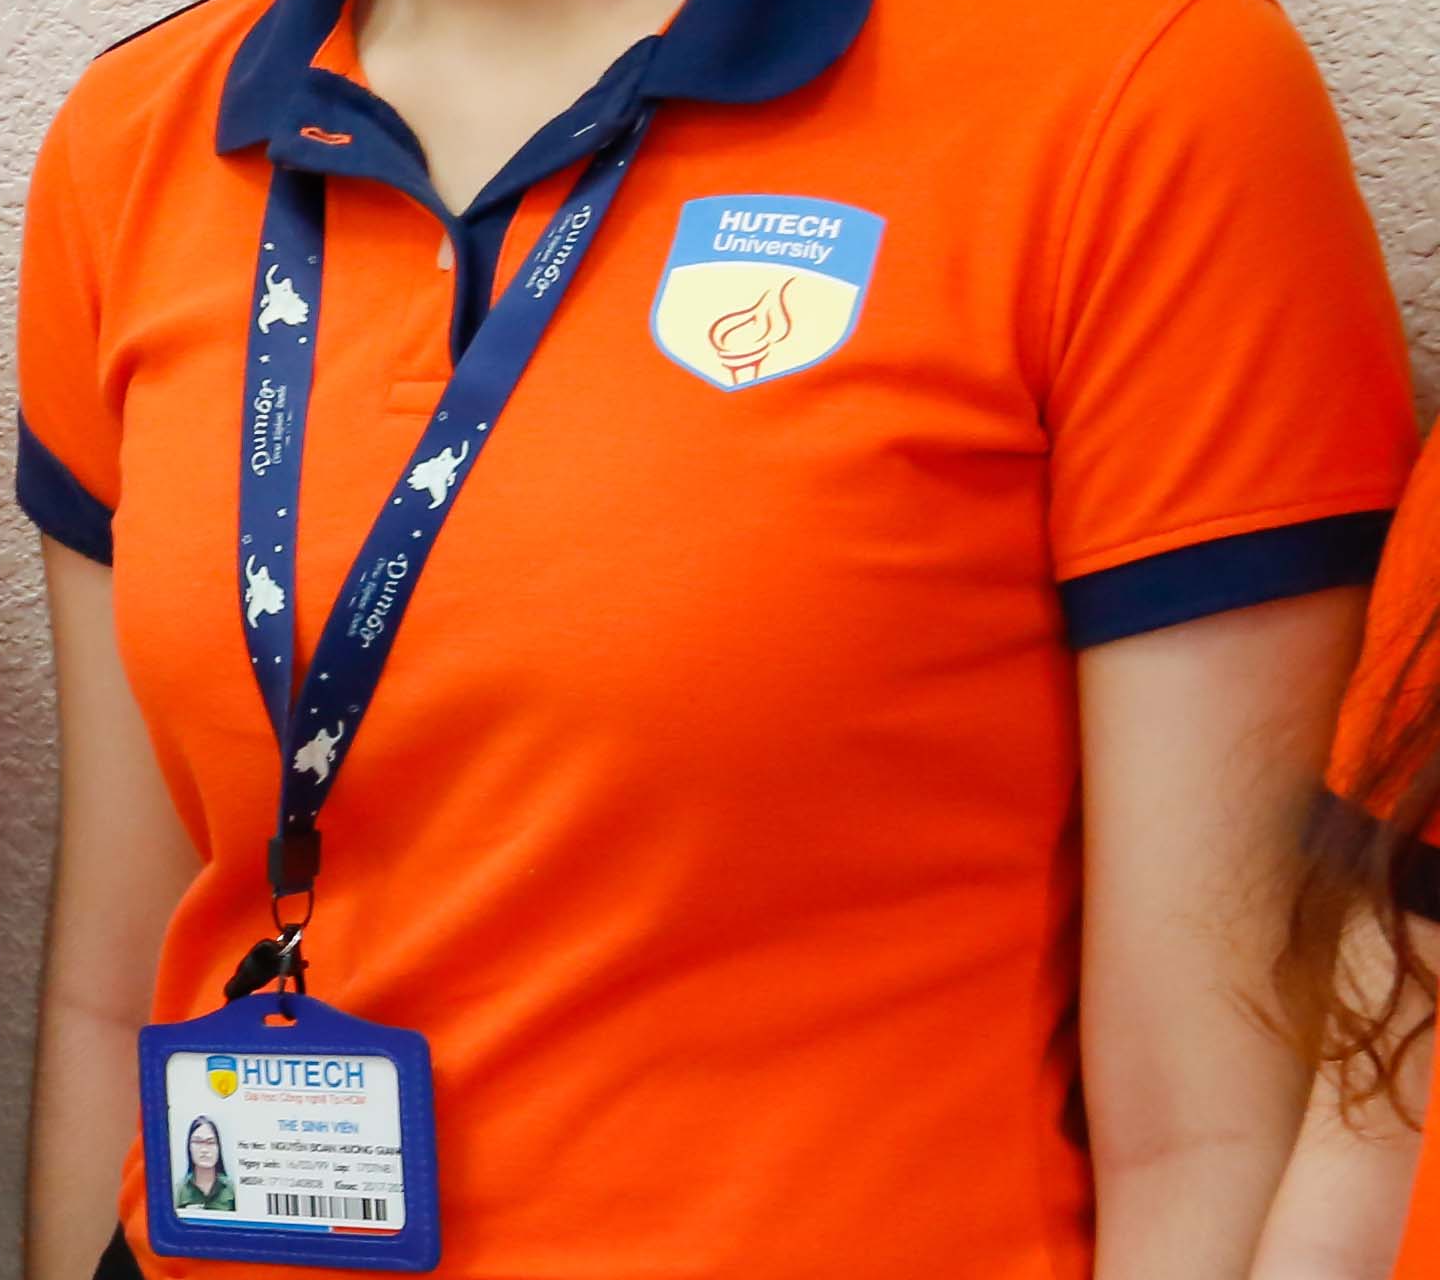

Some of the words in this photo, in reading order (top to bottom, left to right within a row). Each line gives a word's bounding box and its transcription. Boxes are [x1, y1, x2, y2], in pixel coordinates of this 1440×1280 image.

[719, 209, 843, 239] HUTECH
[712, 233, 832, 265] University
[242, 1058, 364, 1088] HUTECH
